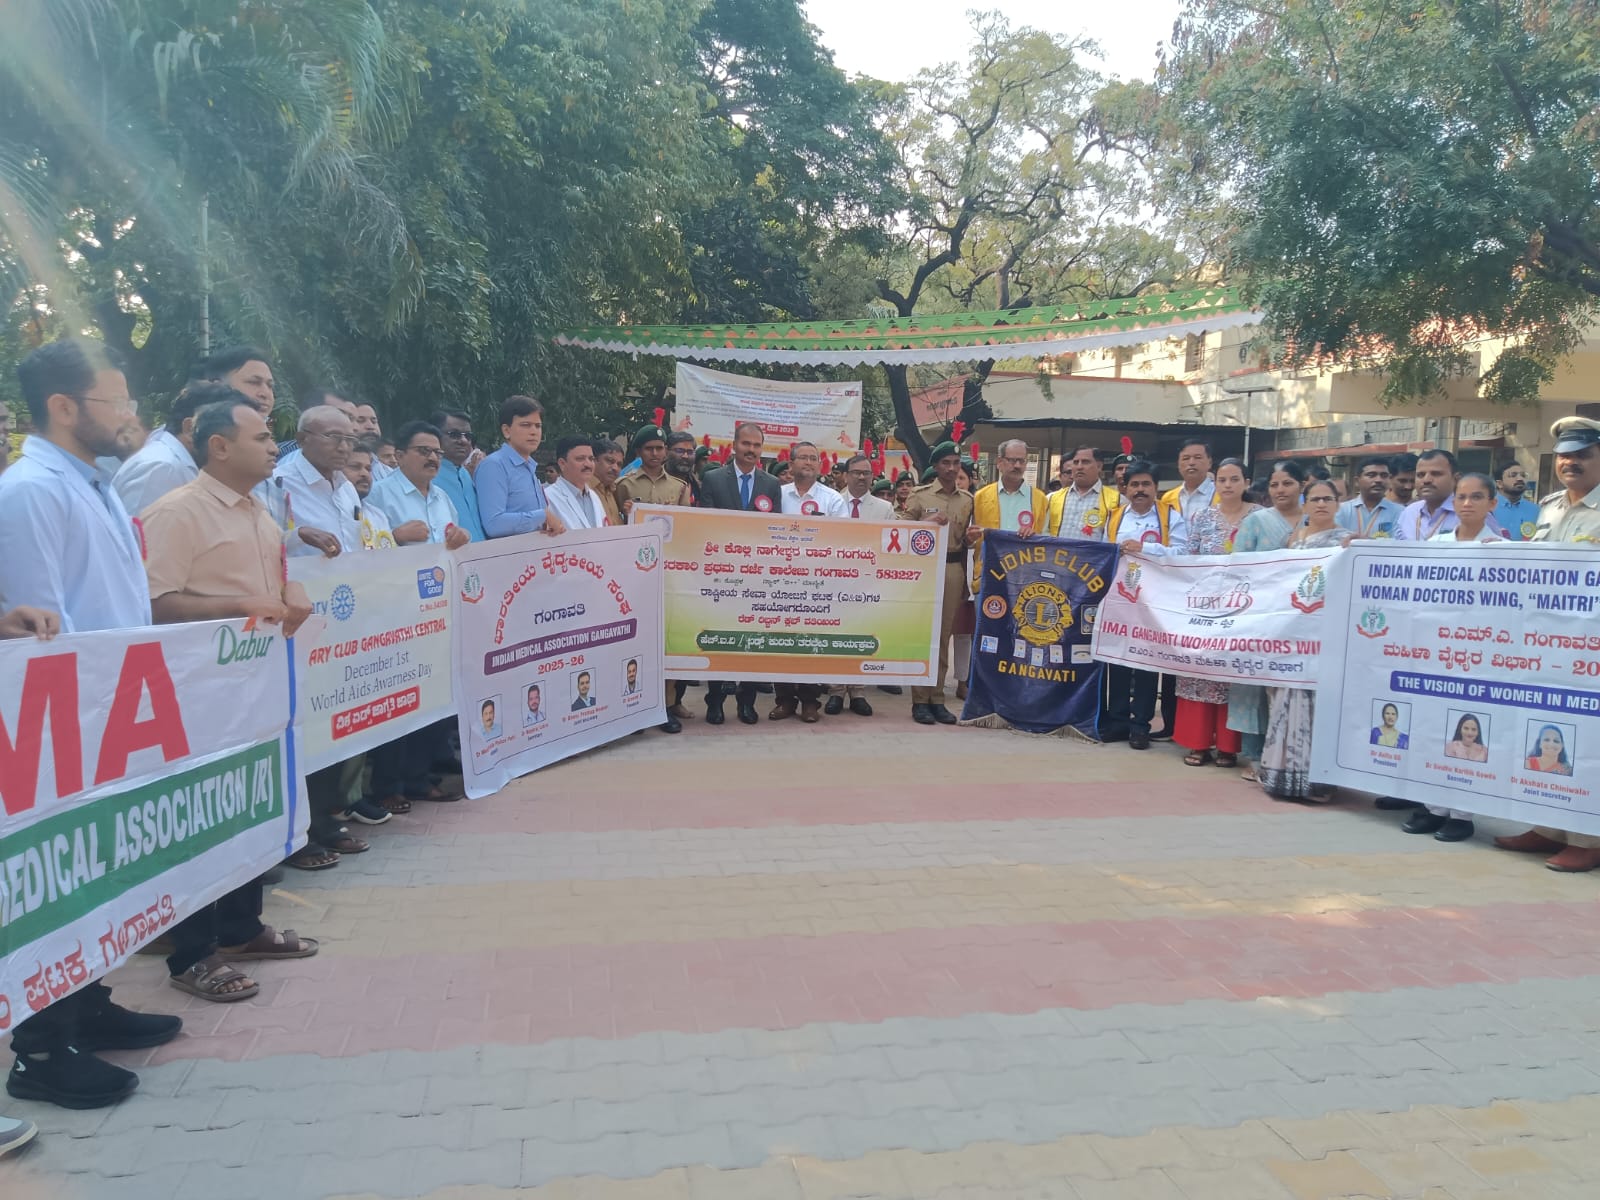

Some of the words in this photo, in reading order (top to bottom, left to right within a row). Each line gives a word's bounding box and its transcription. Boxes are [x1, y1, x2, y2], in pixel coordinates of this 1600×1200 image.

[704, 541, 719, 556] ಶ್ರೀ
[814, 566, 859, 578] ಗಂಗಾವತಿ
[990, 546, 1047, 581] LIONS
[1053, 548, 1104, 593] CLUB
[1368, 563, 1412, 579] INDIAN
[1417, 565, 1474, 582] MEDICAL
[1478, 567, 1579, 587] ASSOCIATION
[1025, 585, 1063, 602] LIONS
[1361, 585, 1410, 602] WOMAN
[1413, 587, 1475, 605] DOCTORS
[1480, 590, 1524, 610] WING,
[534, 603, 586, 625] ಗಂಗಾವತಿ
[1034, 602, 1052, 626] L
[212, 624, 275, 665] Dabur
[334, 639, 359, 659] CLUB
[360, 626, 414, 652] GANGAVATHI
[414, 617, 447, 637] CENTRAL
[492, 650, 516, 668] INDIAN
[515, 642, 543, 660] MEDICAL
[543, 633, 590, 652] ASSOCIATION
[590, 623, 631, 641] GANGAVATHI
[1102, 621, 1128, 637] IMA
[1131, 626, 1178, 647] GANGAVATI
[1181, 634, 1228, 651] WOMAN
[1229, 637, 1291, 655] DOCTORS
[344, 655, 394, 682] December
[396, 651, 409, 667] 1st
[997, 660, 1076, 682] GANGAVATI
[310, 687, 345, 713] World
[348, 681, 371, 701] Aids
[372, 668, 417, 693] Awarness
[418, 663, 433, 678] Day
[1397, 676, 1421, 690] THE
[1423, 678, 1466, 696] VISION
[1468, 685, 1486, 698] OF
[1489, 687, 1543, 704] WOMEN
[1546, 693, 1562, 707] IN
[113, 765, 247, 871] ASSOCIATION
[249, 754, 275, 820] (R)
